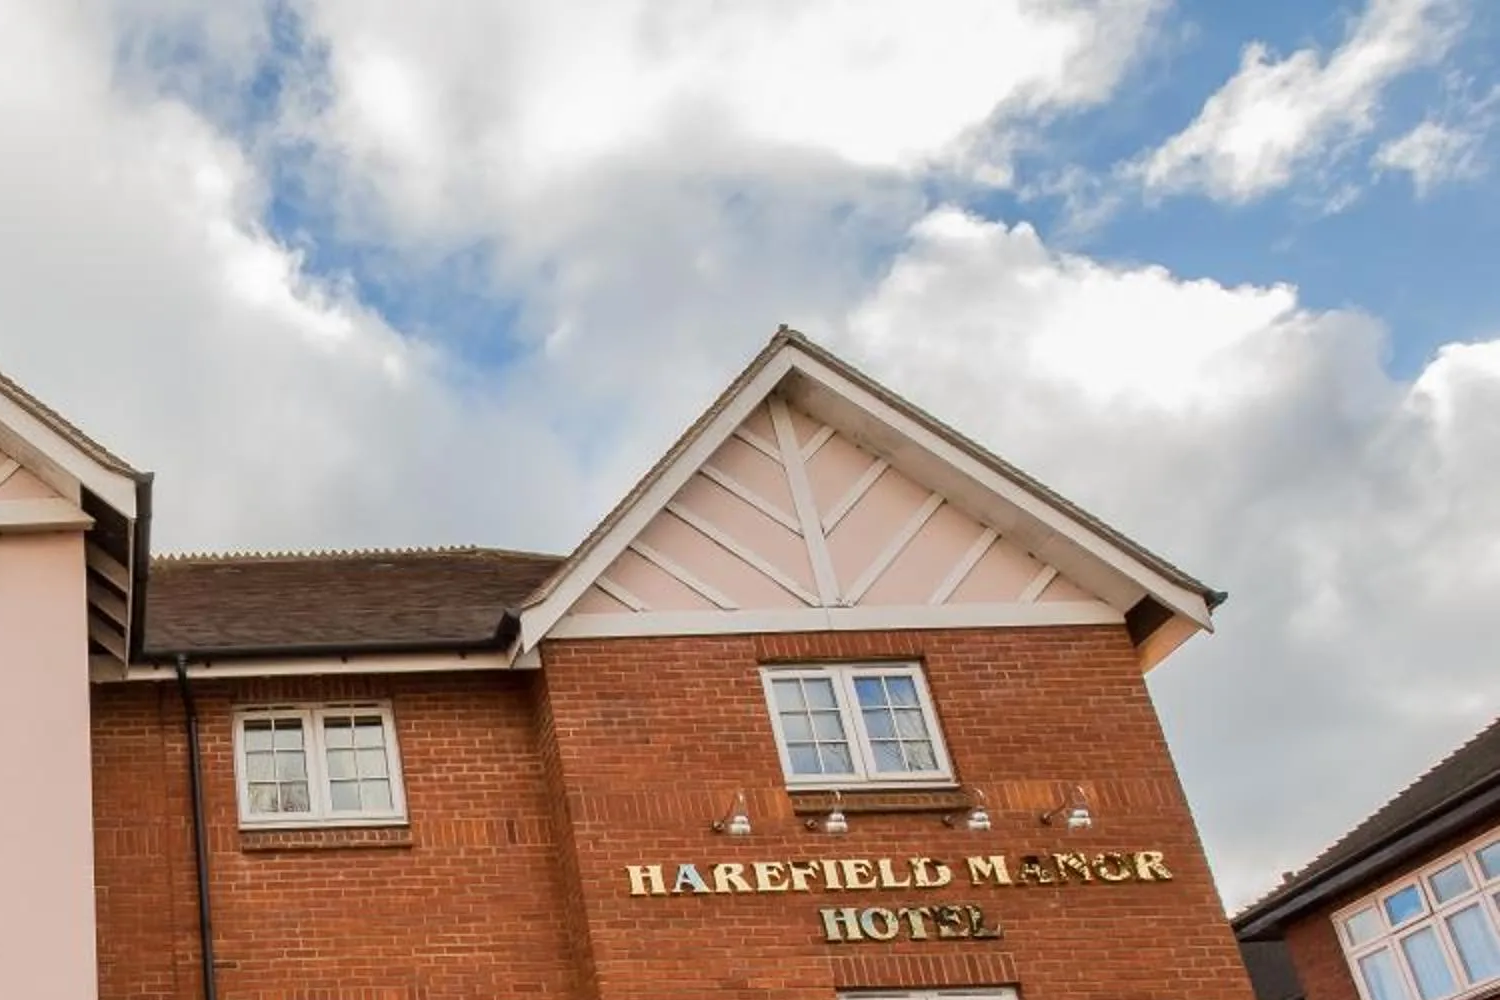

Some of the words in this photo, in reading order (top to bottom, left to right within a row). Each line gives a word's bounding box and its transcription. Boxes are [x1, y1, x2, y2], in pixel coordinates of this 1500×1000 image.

[625, 855, 952, 898] HAREFIELD
[965, 850, 1174, 888] MANOR
[819, 904, 1003, 944] HOTEL
